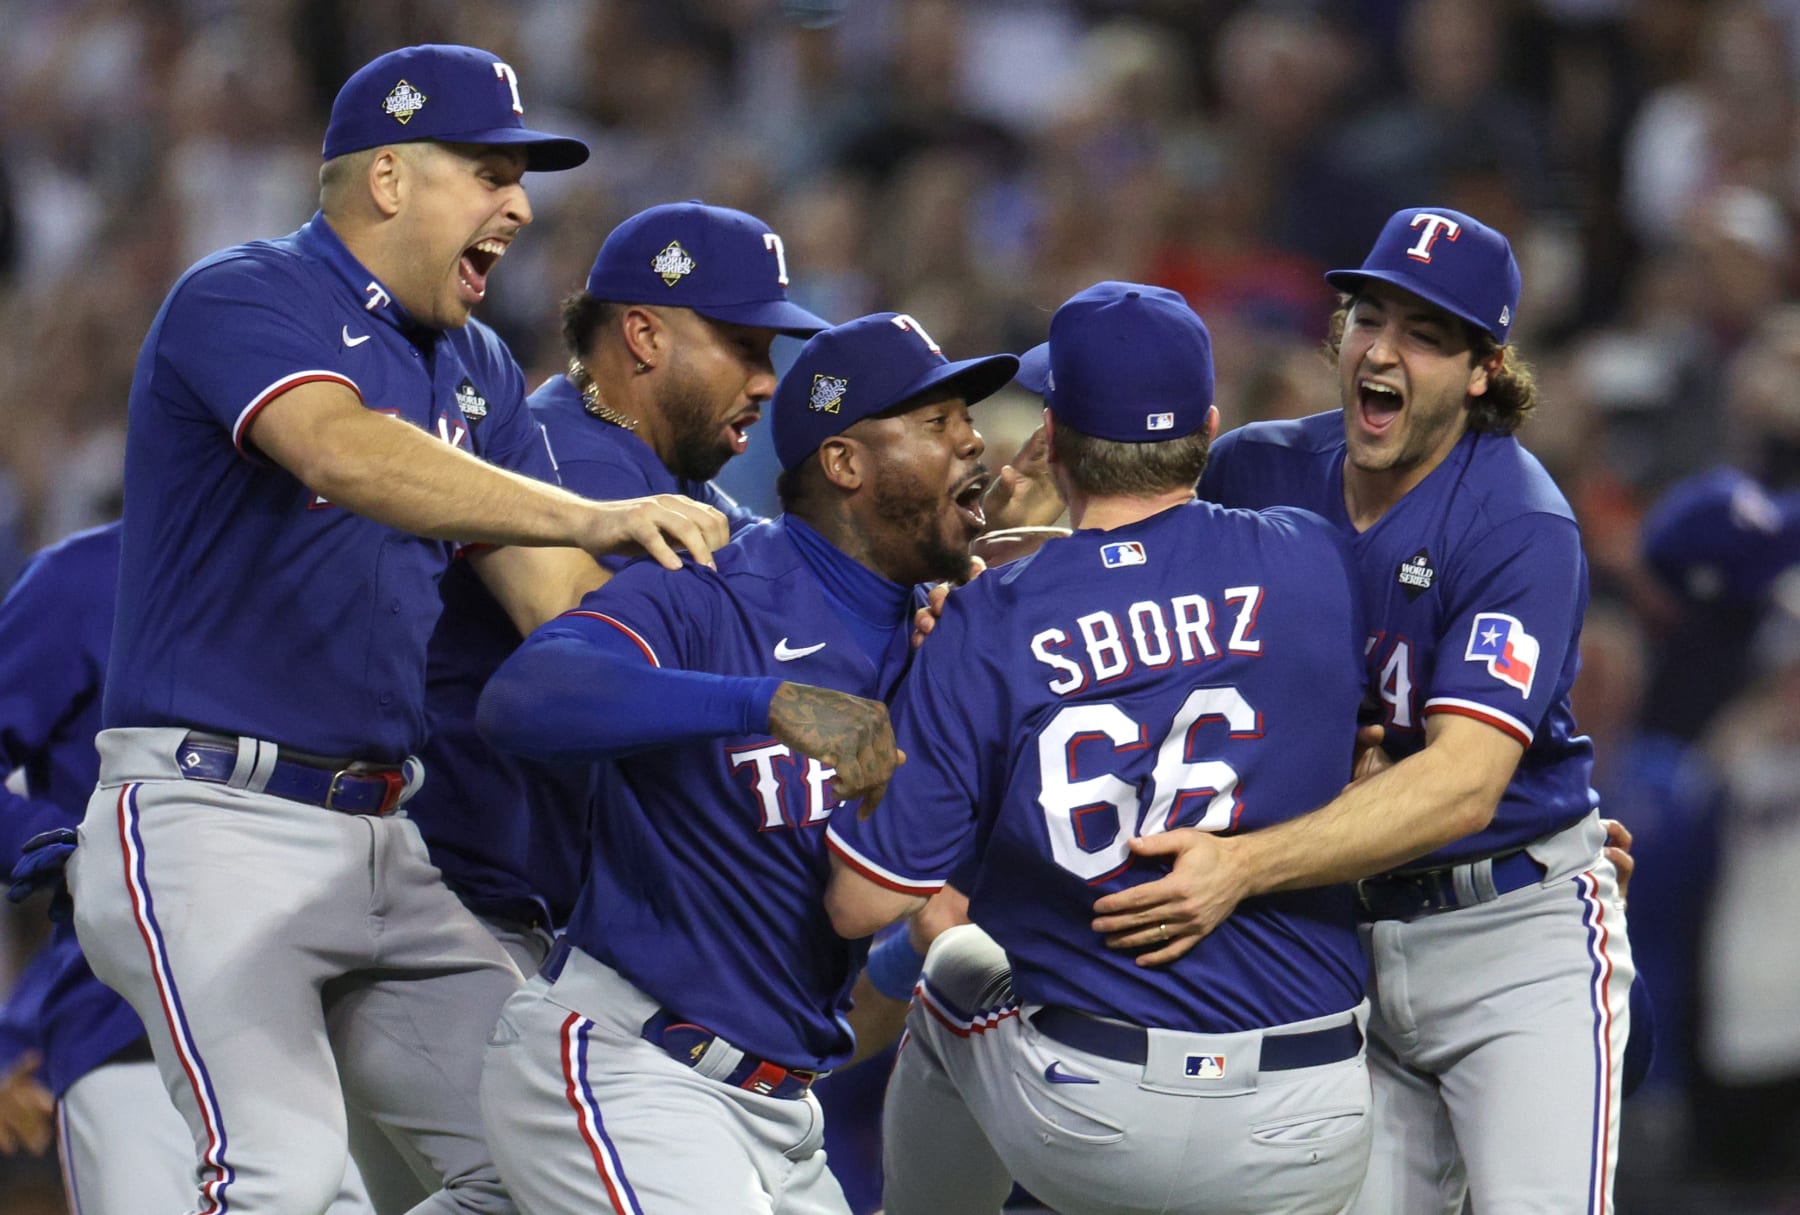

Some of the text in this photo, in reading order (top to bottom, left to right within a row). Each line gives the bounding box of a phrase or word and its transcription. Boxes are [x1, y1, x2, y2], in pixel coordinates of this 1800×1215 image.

[385, 92, 422, 105] WORLD
[492, 62, 523, 115] T
[385, 100, 423, 114] SERIES
[1407, 213, 1461, 264] T
[654, 263, 691, 275] SERIES
[655, 255, 692, 266] WORLD
[762, 233, 789, 287] T
[364, 281, 391, 311] T
[890, 313, 942, 354] T
[1398, 572, 1432, 588] SERIES
[1401, 563, 1434, 579] WORLD
[1031, 585, 1264, 695] SBORZ
[1036, 683, 1265, 886] 66
